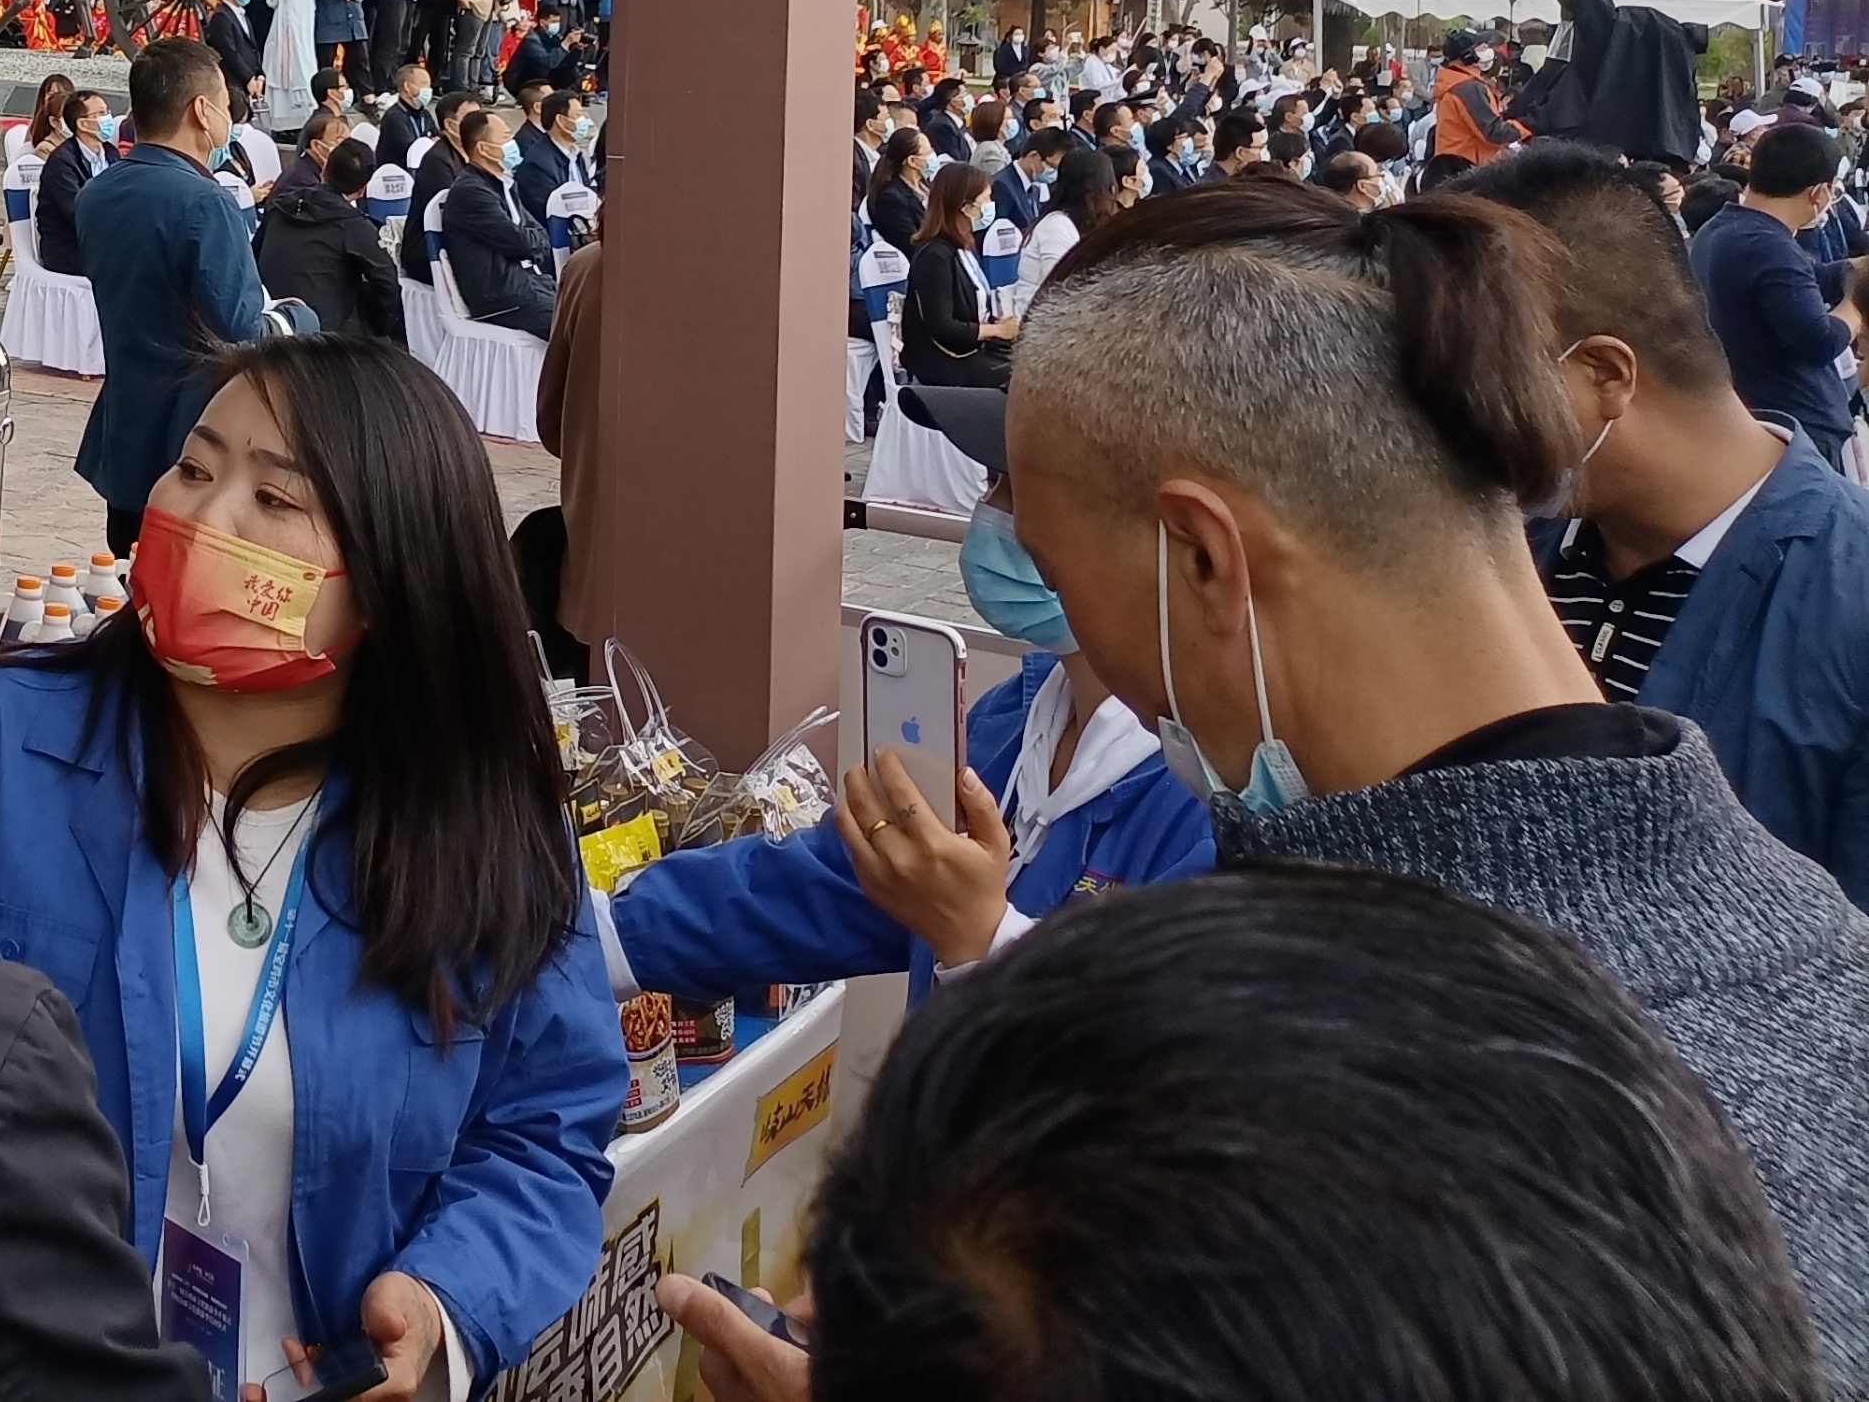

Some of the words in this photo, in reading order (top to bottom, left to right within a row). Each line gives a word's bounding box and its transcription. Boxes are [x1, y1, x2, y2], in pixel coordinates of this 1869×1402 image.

[243, 574, 294, 604] 我爱你
[246, 596, 280, 622] 中国
[759, 1063, 832, 1145] 岐山天缘
